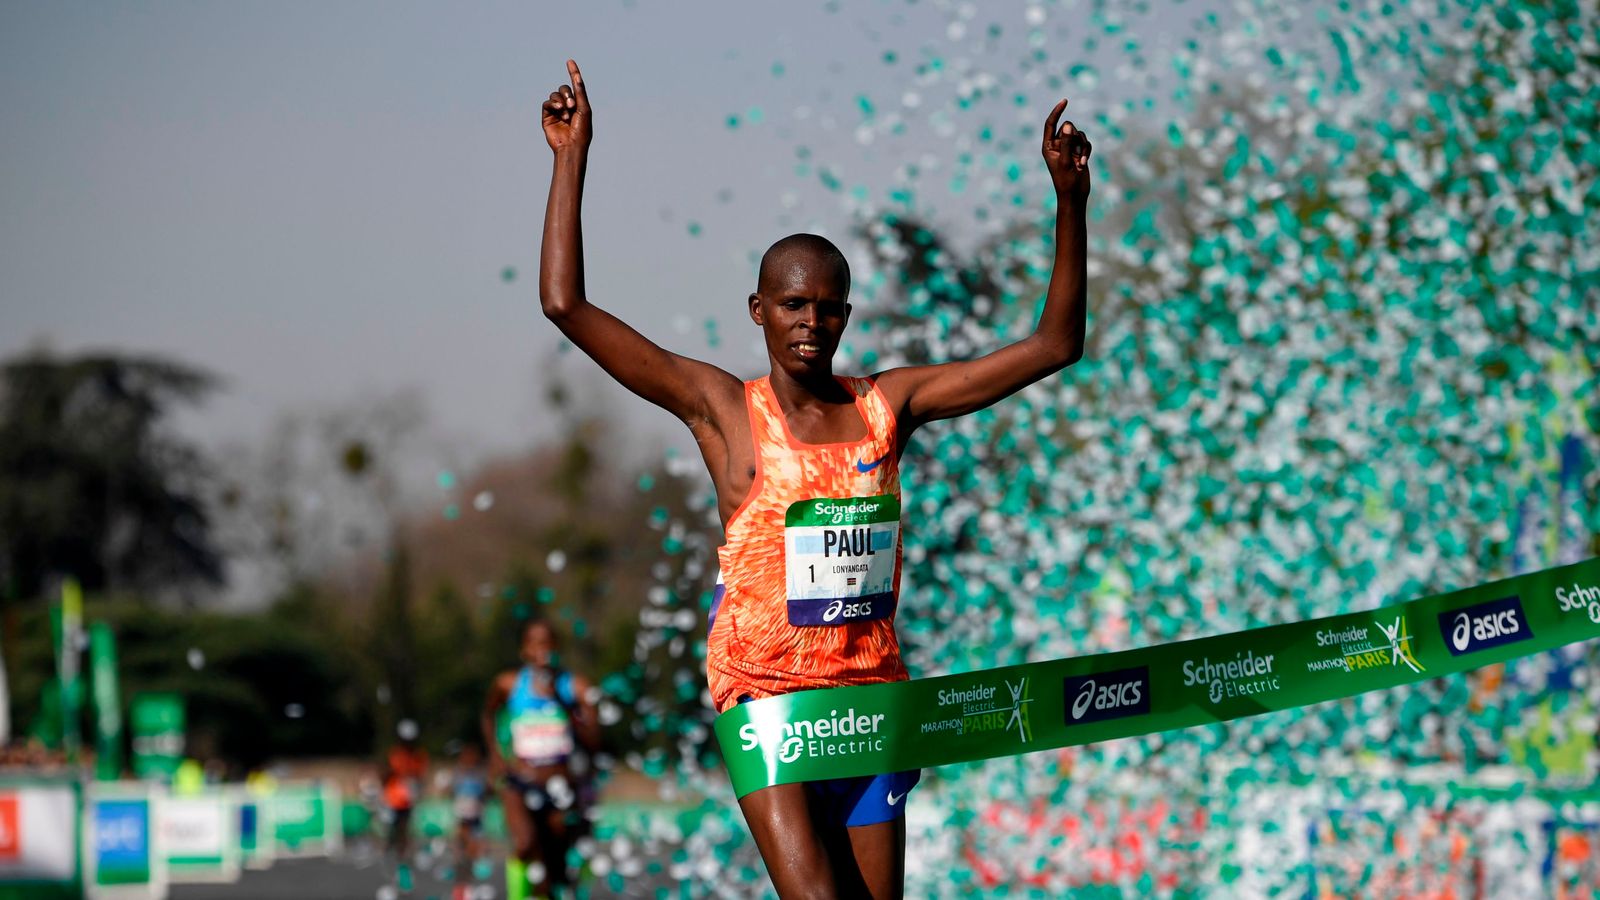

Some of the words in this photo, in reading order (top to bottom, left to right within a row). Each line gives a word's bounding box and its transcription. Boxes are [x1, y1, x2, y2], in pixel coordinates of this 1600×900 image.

[814, 502, 880, 515] Schneider
[823, 528, 876, 557] PAUL
[808, 564, 815, 583] 1
[832, 564, 869, 574] LONYANGATA
[1473, 609, 1519, 641] asics
[1316, 626, 1368, 647] Schneider
[1341, 641, 1373, 655] Electric
[1183, 650, 1274, 687] Schneider
[1307, 656, 1348, 672] MARATHON
[1347, 650, 1390, 671] PARIS
[938, 685, 996, 706] Schneider
[1094, 680, 1142, 710] asics
[1226, 678, 1280, 698] Electric
[962, 701, 995, 713] Electric
[738, 708, 884, 751] Sneider
[921, 718, 963, 734] MARATHON
[963, 712, 1005, 733] PARIS
[809, 738, 883, 757] Electric
